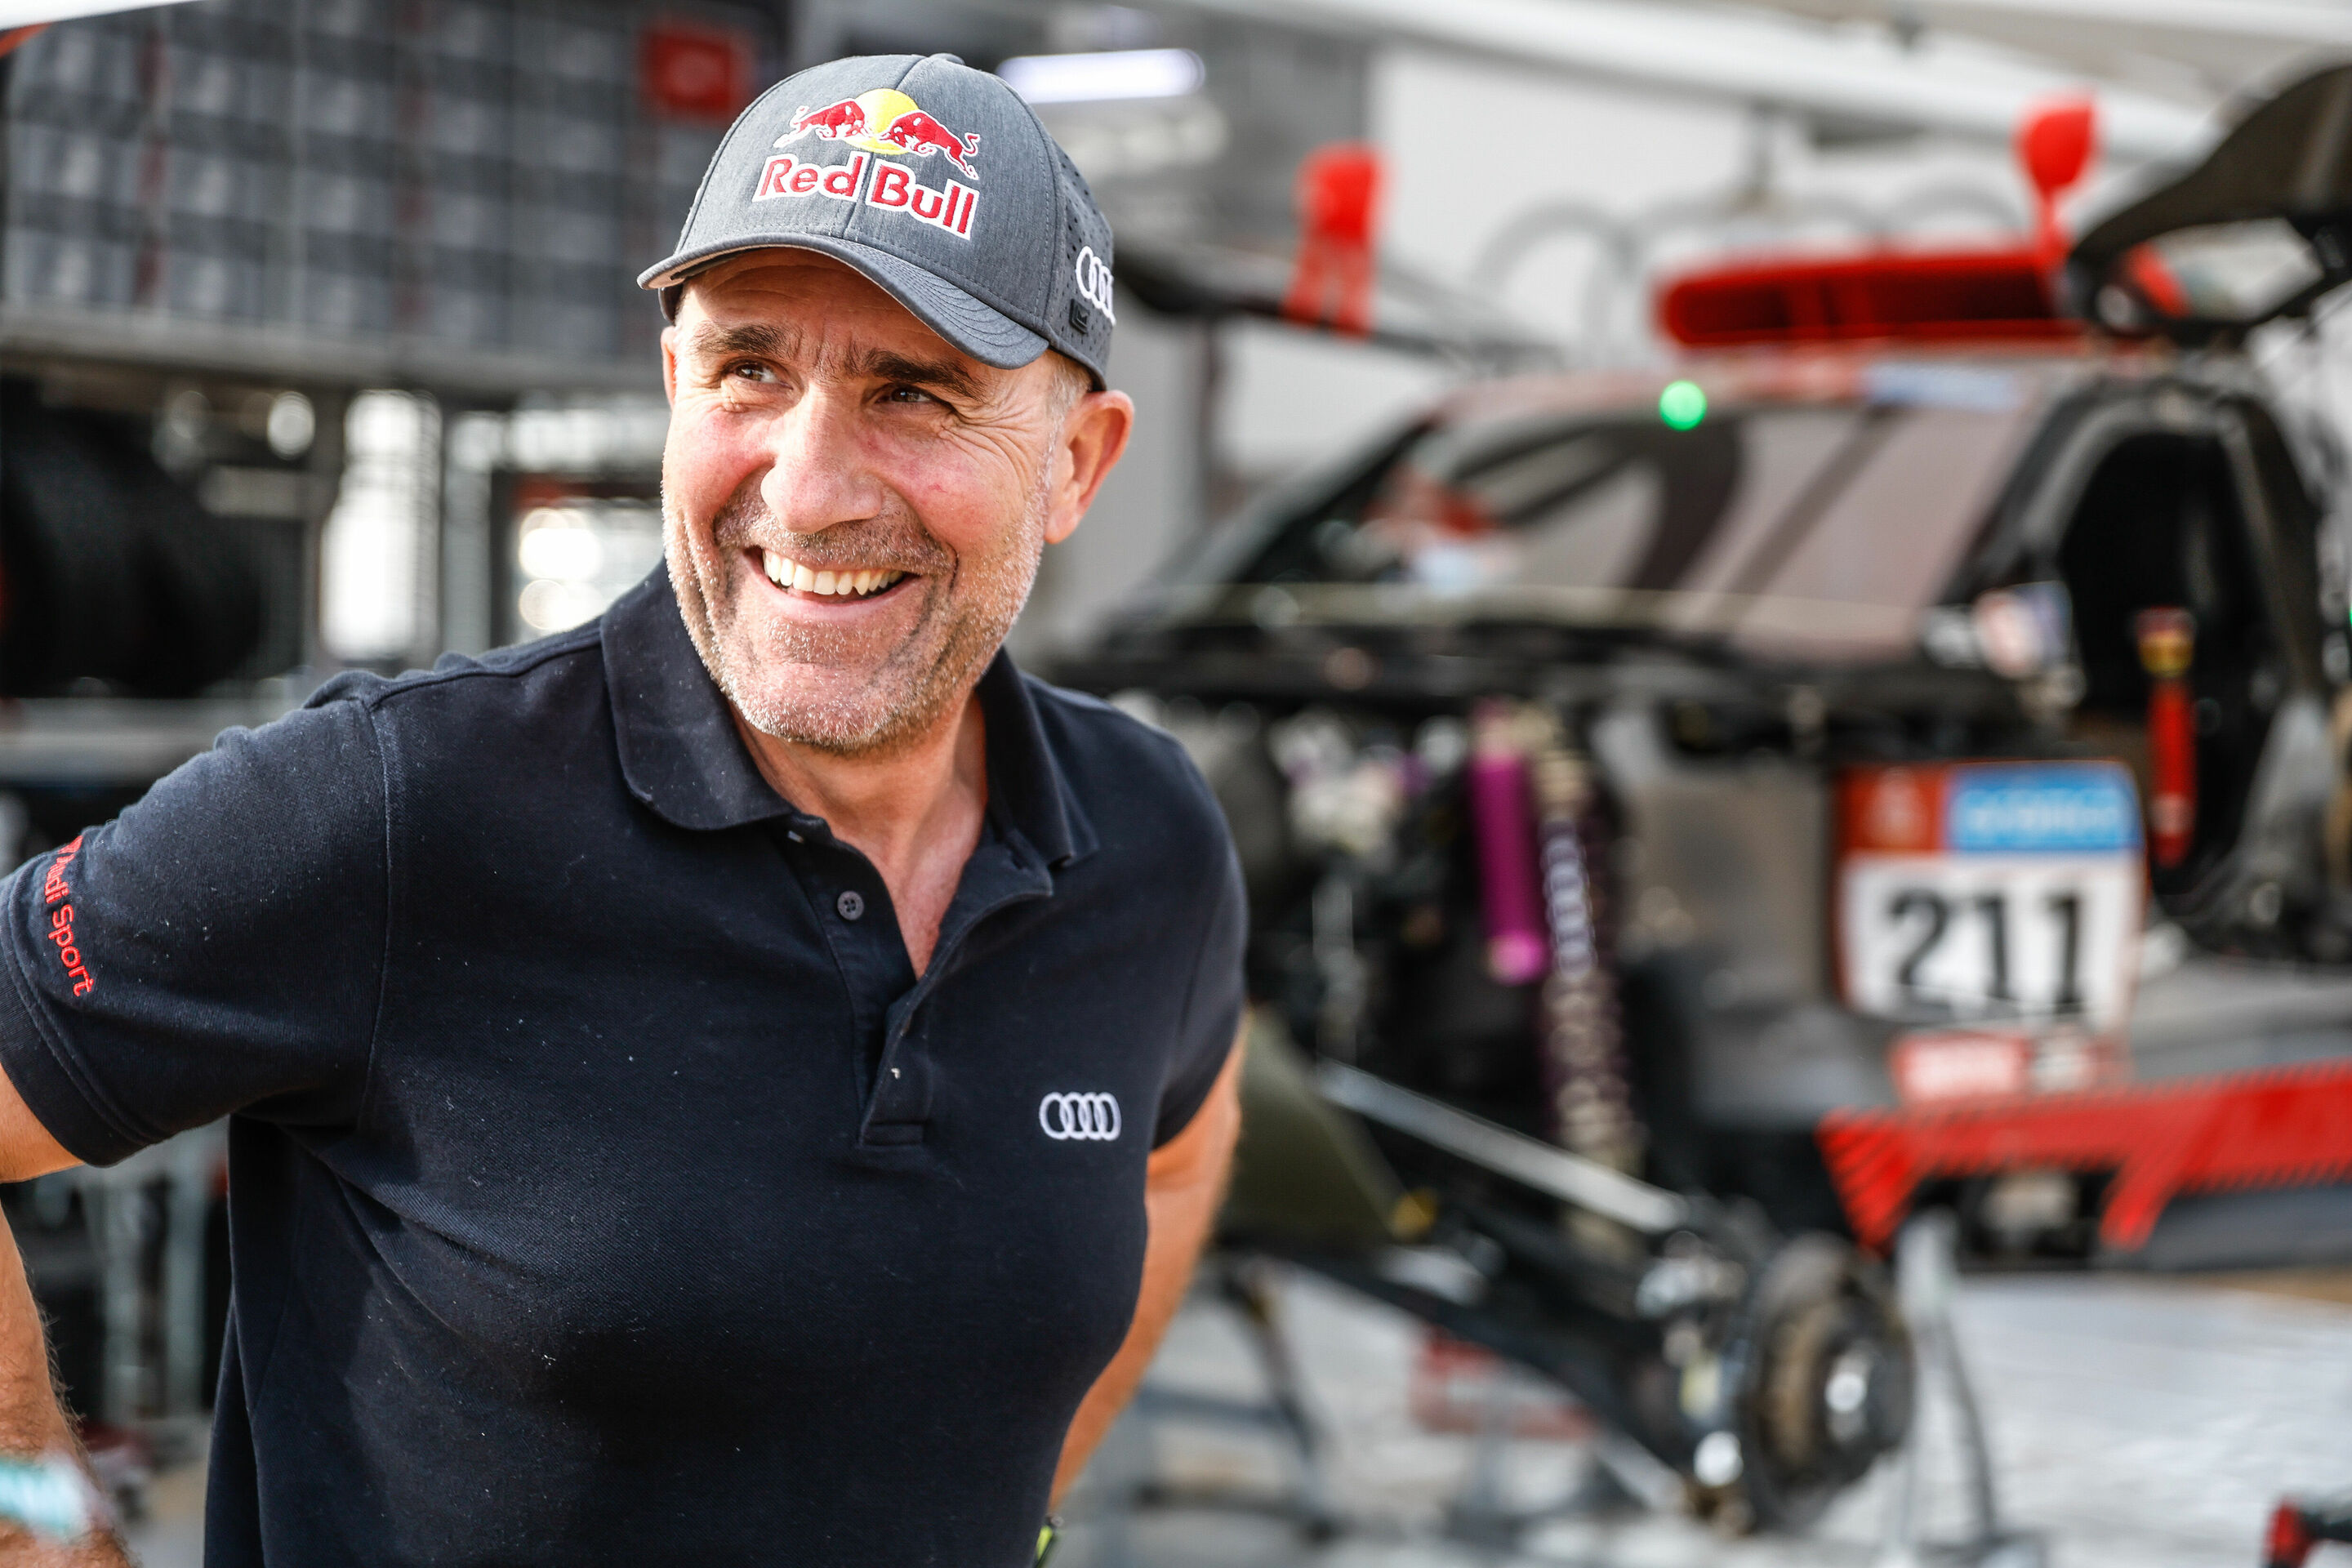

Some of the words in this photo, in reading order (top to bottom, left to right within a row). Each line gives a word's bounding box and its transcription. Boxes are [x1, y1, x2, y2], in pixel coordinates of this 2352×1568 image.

[752, 151, 867, 202] Red
[866, 159, 980, 240] Bull
[1887, 889, 2083, 1018] 211
